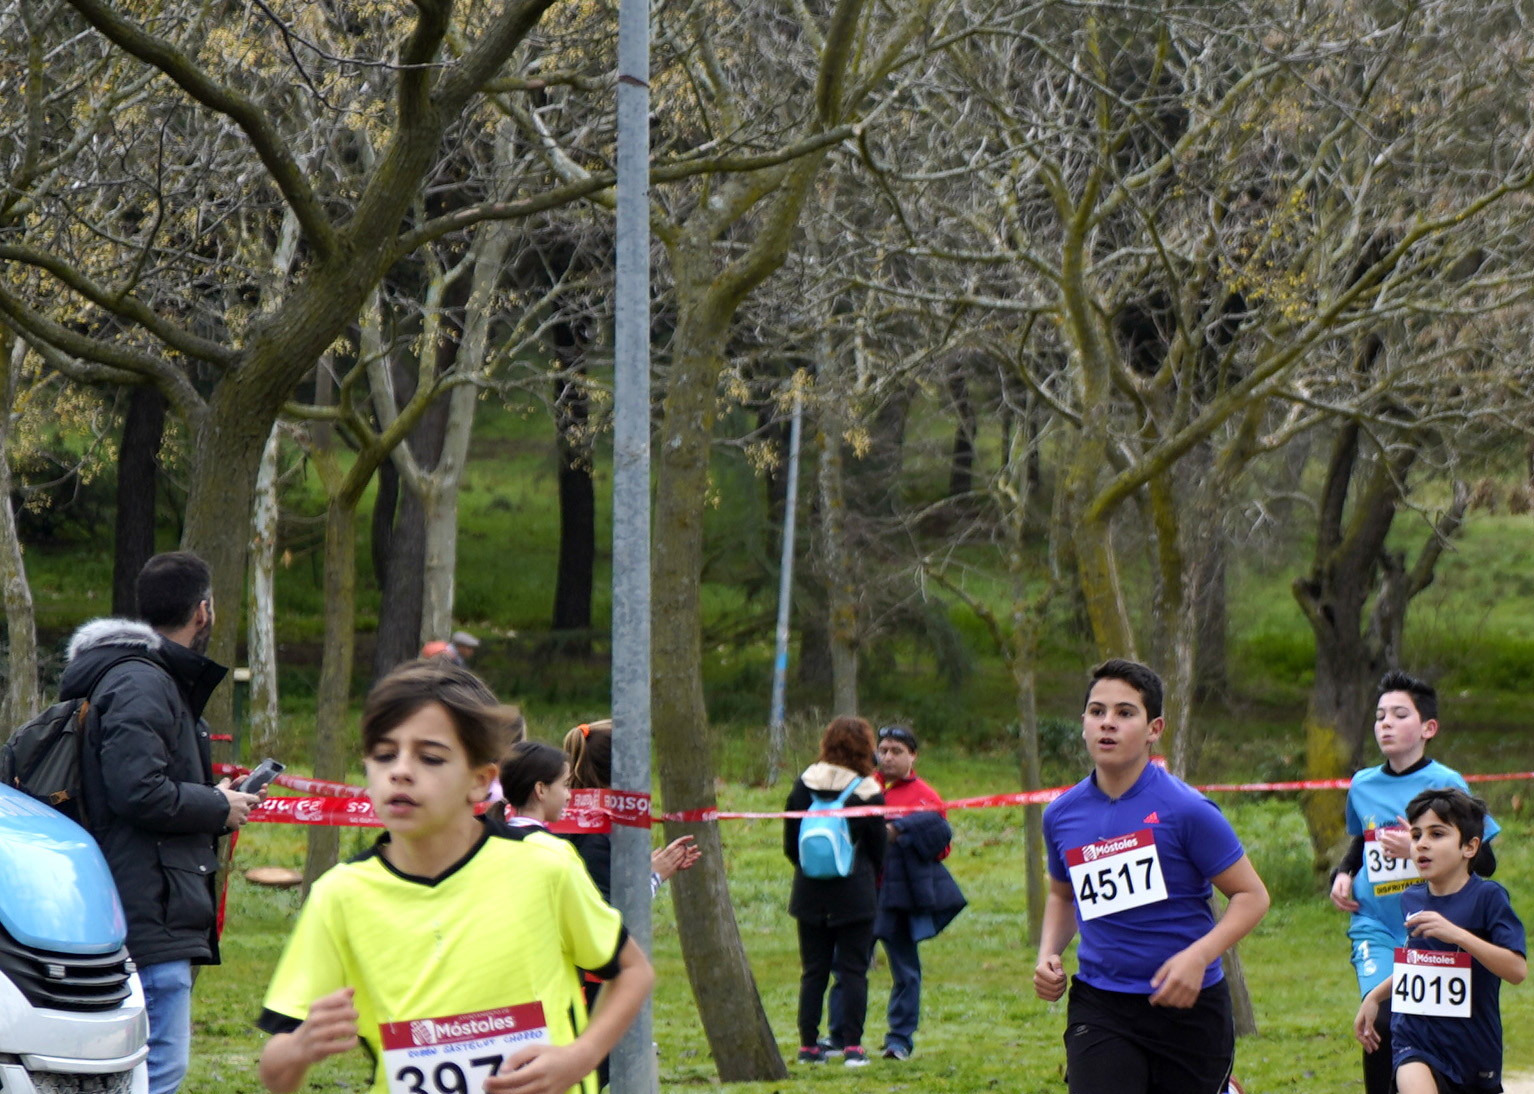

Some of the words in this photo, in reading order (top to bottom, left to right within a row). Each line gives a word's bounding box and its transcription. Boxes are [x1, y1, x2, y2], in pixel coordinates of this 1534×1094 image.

[1096, 837, 1138, 855] Móstoles
[1079, 856, 1154, 905] 4517
[1416, 953, 1456, 965] Móstoles
[1395, 973, 1467, 1005] 4019
[435, 1015, 516, 1040] Móstoles
